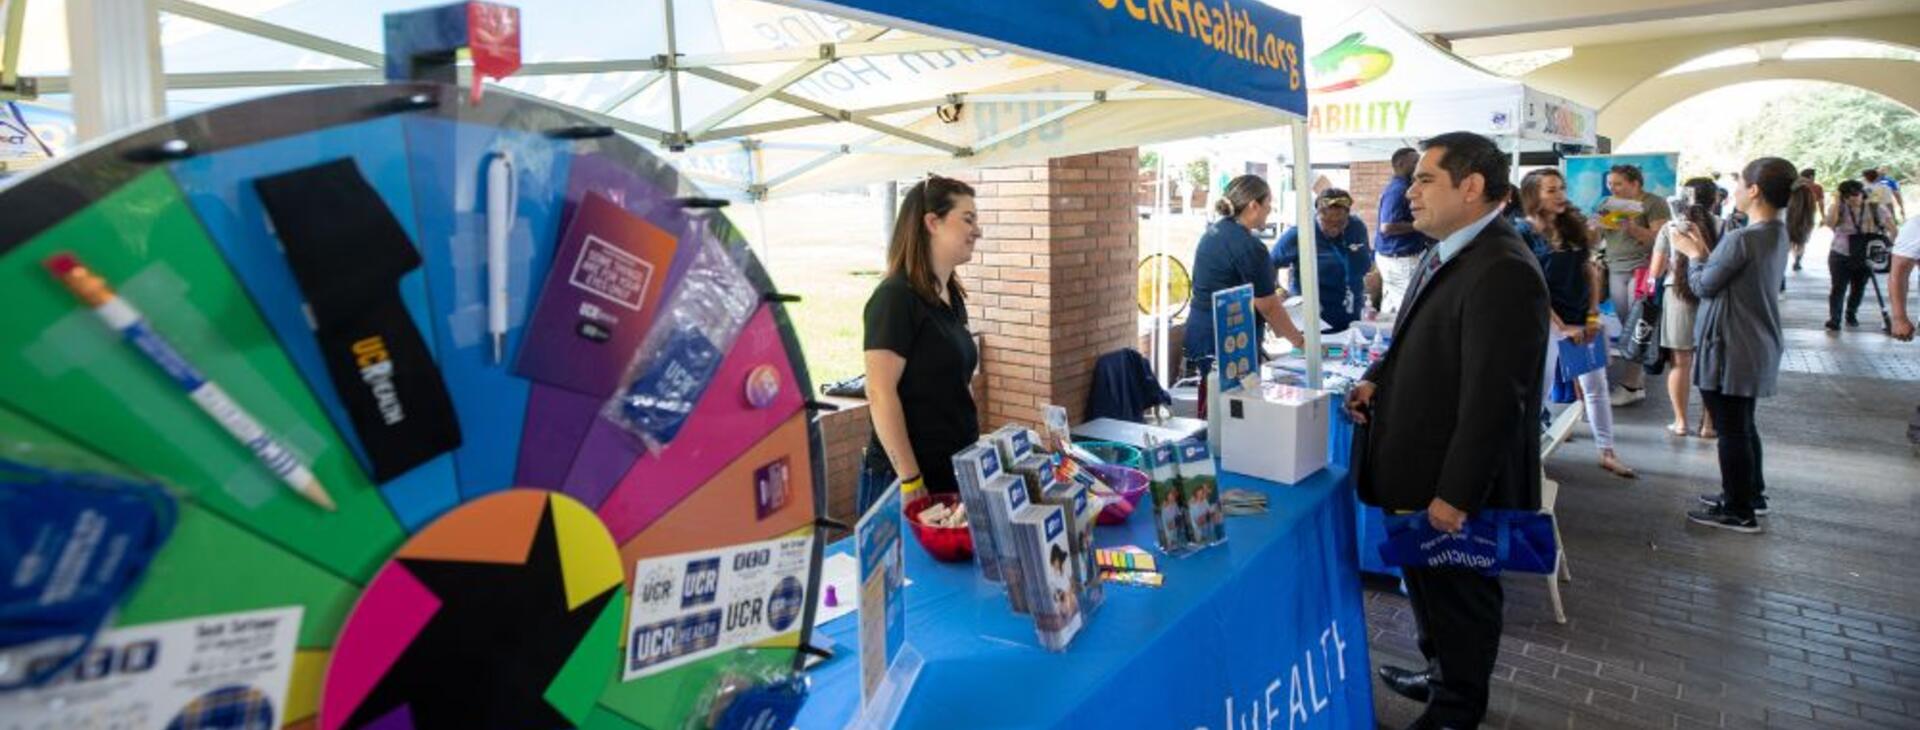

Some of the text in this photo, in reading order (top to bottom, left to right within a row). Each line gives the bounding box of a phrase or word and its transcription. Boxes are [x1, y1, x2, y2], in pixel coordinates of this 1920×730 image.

[1098, 0, 1300, 90] RHealth.org
[1308, 100, 1412, 133] ABILITY
[642, 579, 672, 604] UCR
[684, 567, 719, 593] UCR
[727, 598, 762, 631] UCR
[638, 627, 674, 662] UCR
